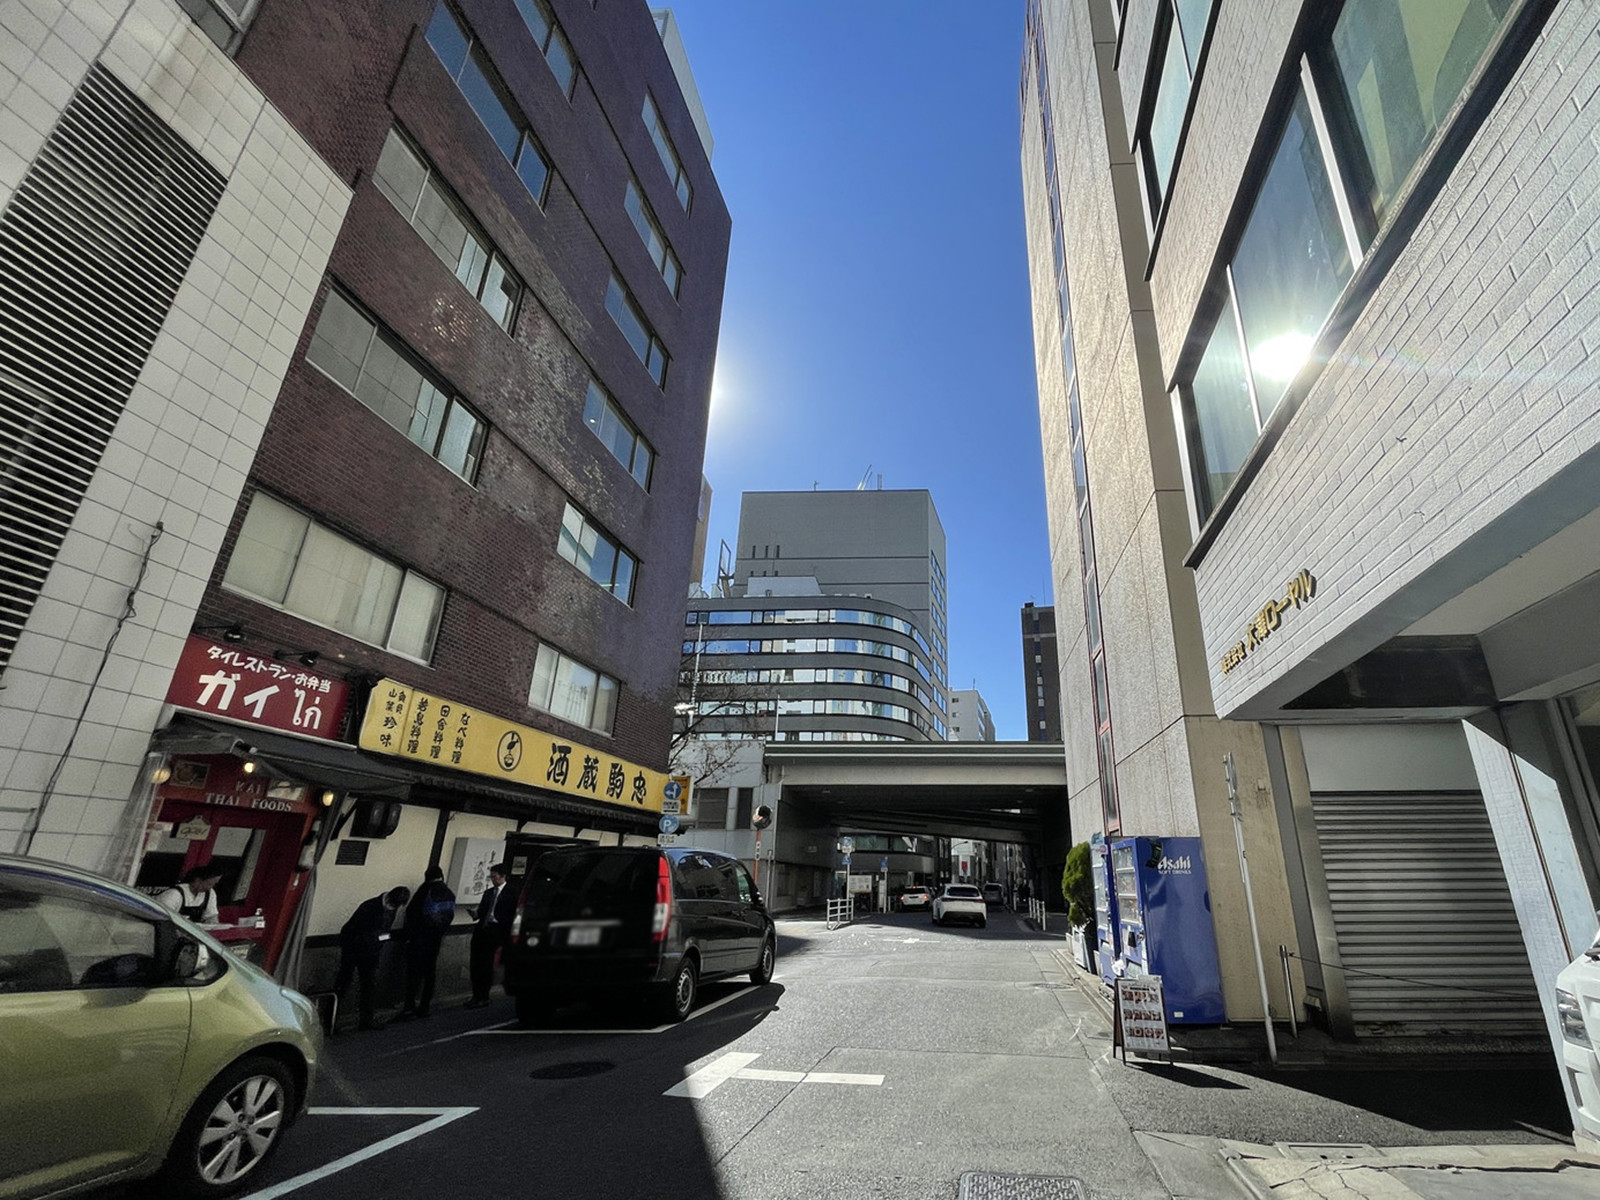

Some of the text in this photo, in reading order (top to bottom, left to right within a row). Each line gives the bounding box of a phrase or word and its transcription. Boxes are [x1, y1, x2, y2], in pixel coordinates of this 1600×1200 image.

[207, 645, 332, 693] タイレストラン・お弁当
[196, 669, 280, 718] ガイ
[235, 780, 261, 794] KAI
[205, 792, 293, 812] THAI FOODS
[663, 819, 672, 831] P
[1157, 855, 1192, 870] Asahi
